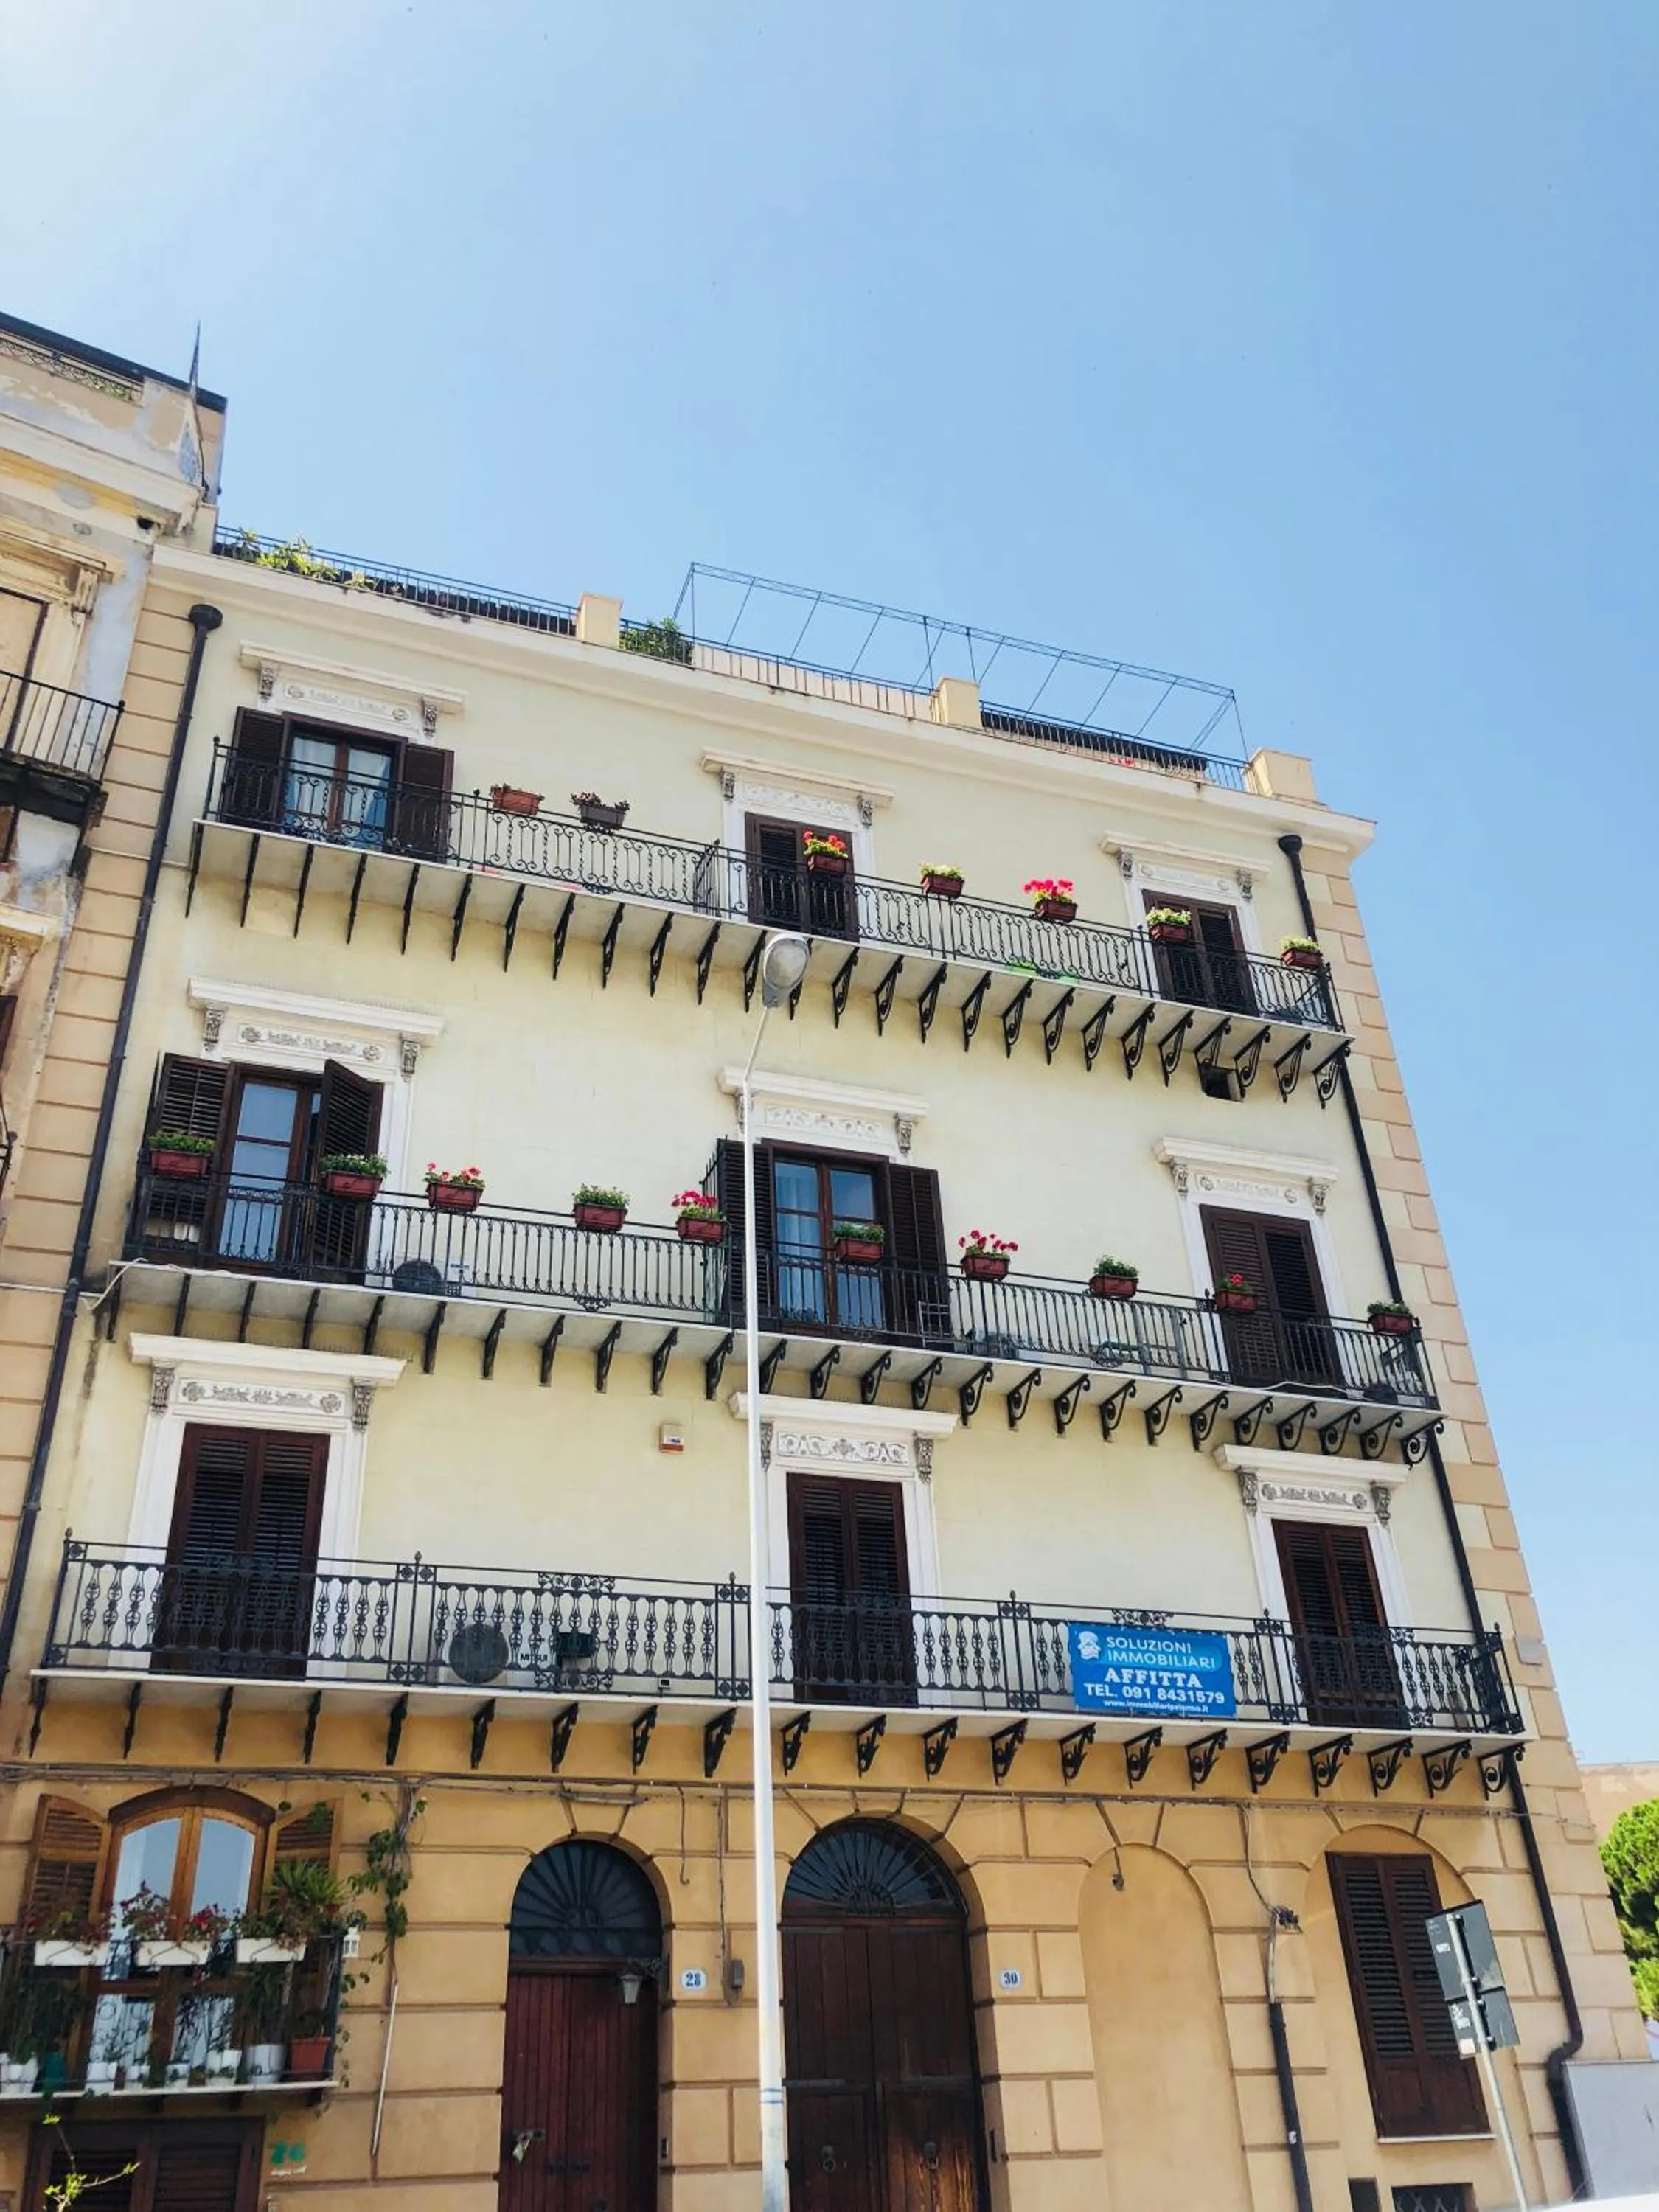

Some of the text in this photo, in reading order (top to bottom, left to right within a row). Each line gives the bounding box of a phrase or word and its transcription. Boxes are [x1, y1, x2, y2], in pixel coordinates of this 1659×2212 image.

[1106, 1636, 1192, 1653] SOLUZIONI
[1107, 1649, 1215, 1669] IMMOBILIARI
[1105, 1667, 1203, 1688] AFFITTA
[1083, 1683, 1225, 1704] TEL. 091 8431579
[686, 1972, 701, 1987] 28
[1004, 1972, 1018, 1985] 30
